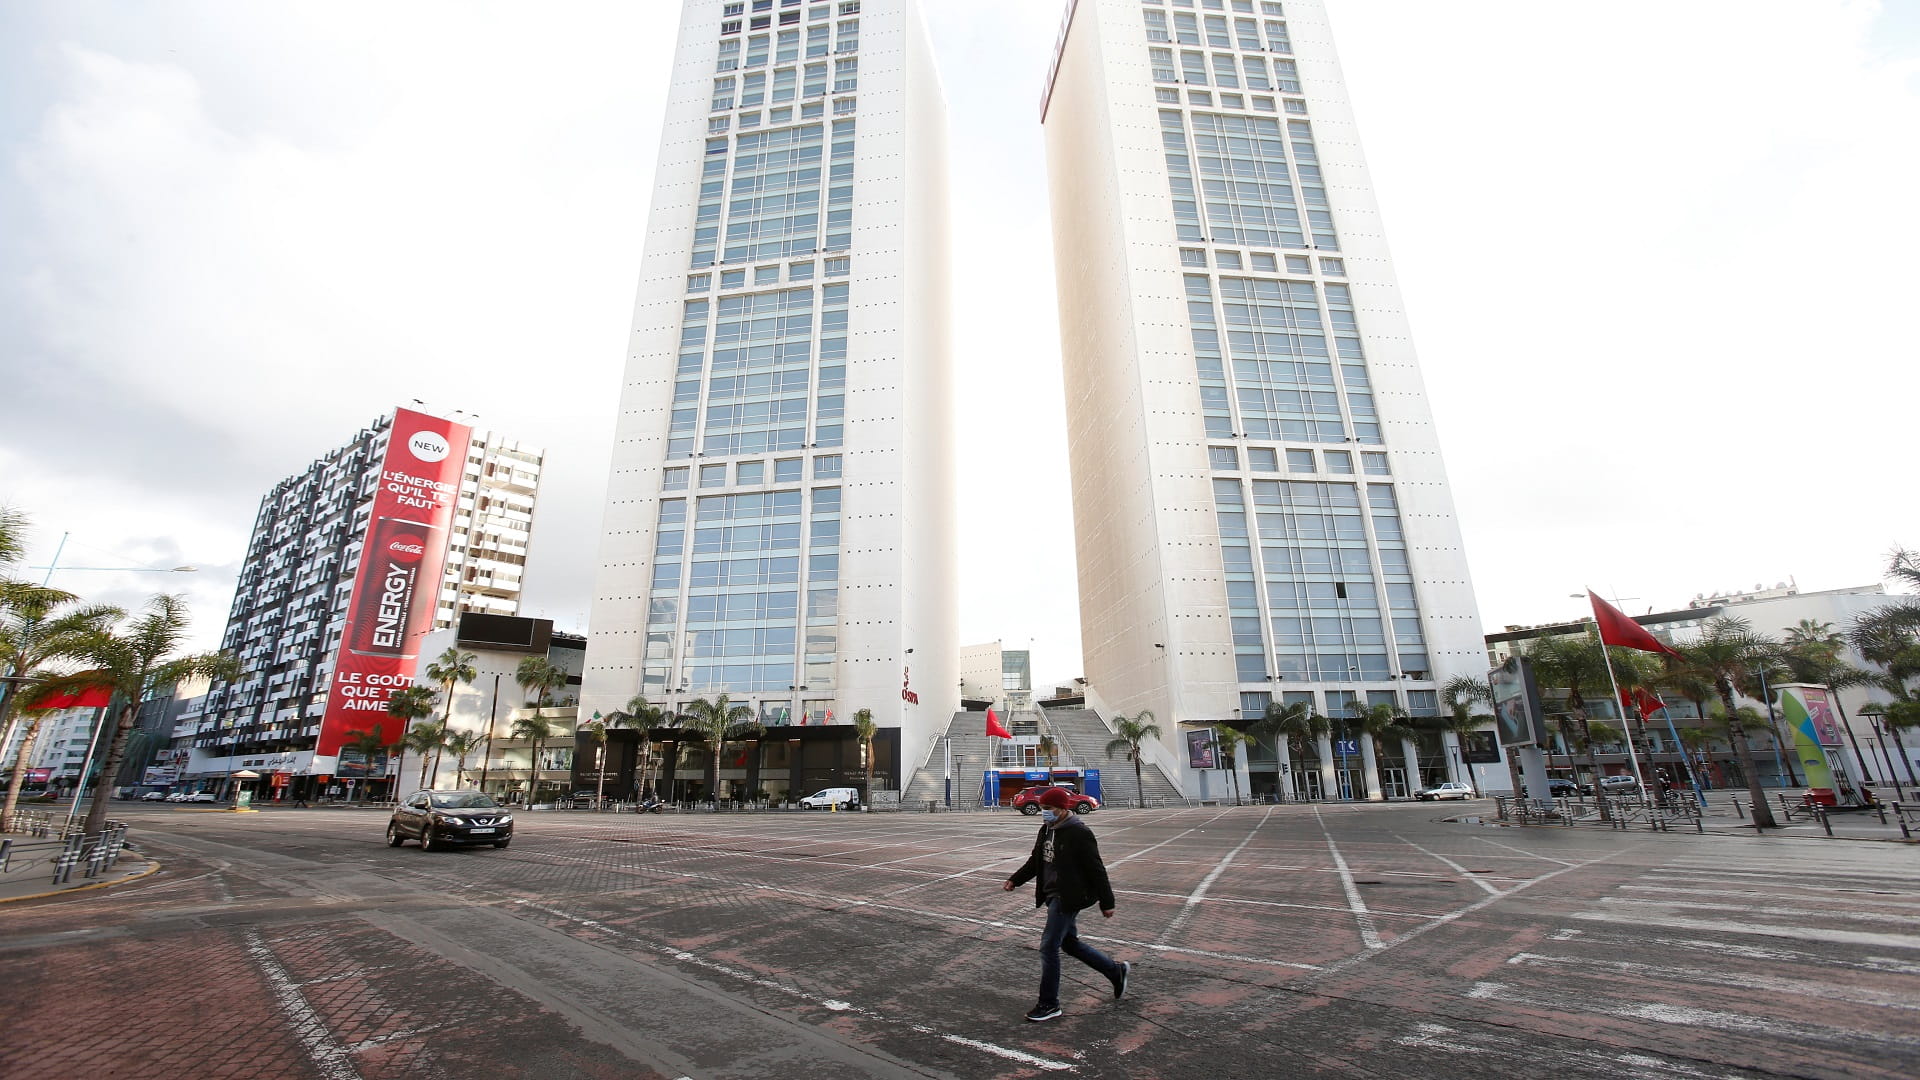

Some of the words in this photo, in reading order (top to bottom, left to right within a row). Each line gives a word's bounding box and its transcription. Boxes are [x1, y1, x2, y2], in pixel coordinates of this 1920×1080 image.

[414, 440, 445, 454] NEW
[387, 482, 426, 499] QU'IL
[430, 490, 449, 503] TE
[396, 494, 436, 510] FAUT
[372, 562, 409, 648] ENERGY
[338, 671, 362, 684] LE
[366, 673, 415, 688] GOÛT
[341, 685, 382, 698] QUE
[342, 698, 390, 712] AIME
